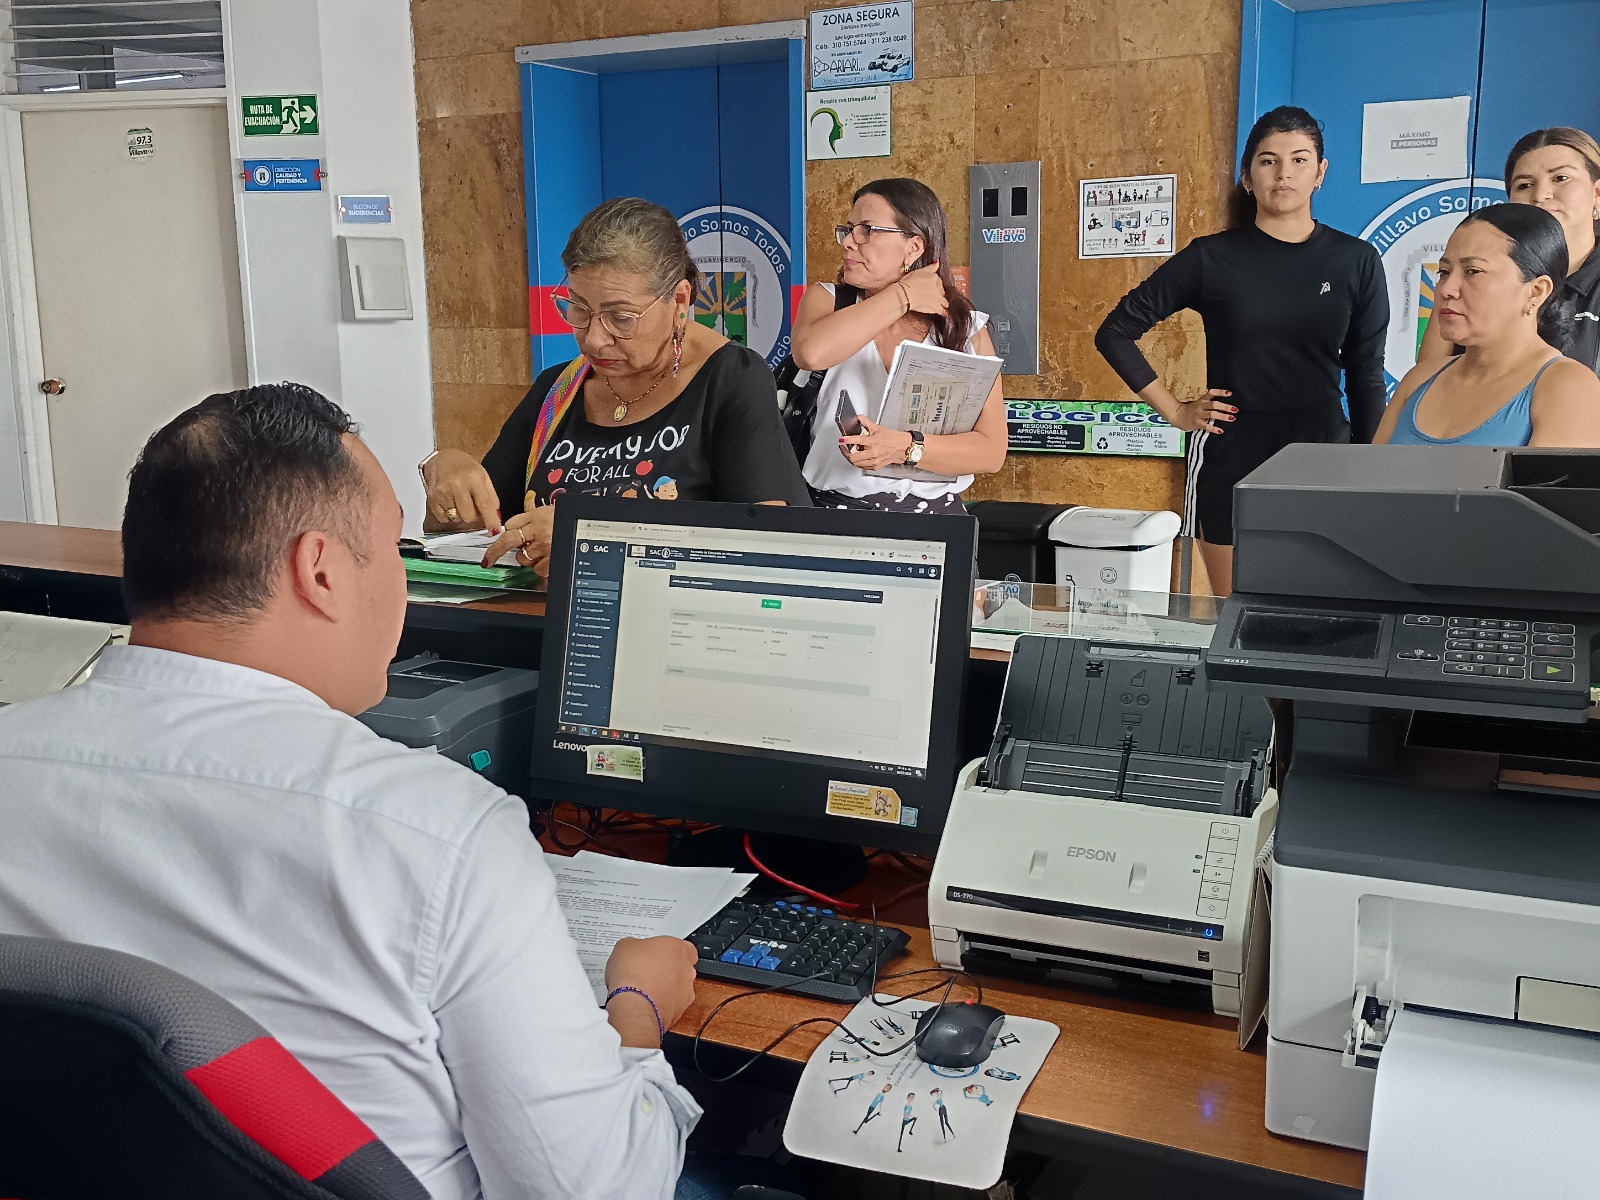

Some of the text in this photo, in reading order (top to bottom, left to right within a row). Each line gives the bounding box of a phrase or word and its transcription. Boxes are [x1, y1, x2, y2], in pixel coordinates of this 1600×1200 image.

[822, 7, 900, 26] ZONA SEGURA
[249, 104, 274, 115] RUTA DE
[244, 114, 280, 126] EVACUACIÓN
[136, 135, 152, 145] 97.3
[1398, 139, 1437, 147] PERSONAS
[1438, 195, 1505, 213] Som
[700, 219, 750, 236] Somos
[753, 228, 786, 274] Todos
[697, 256, 747, 264] ILLAVIENCIO
[1007, 404, 1169, 424] LÓGICO
[1017, 428, 1068, 436] APROVECHABLES
[1108, 431, 1163, 439] APROVECHABLES
[564, 464, 631, 484] FOR ALL
[593, 545, 609, 553] SAC
[552, 739, 587, 753] Lenovo
[1066, 846, 1117, 863] EPSON
[953, 891, 973, 900] DS-770
